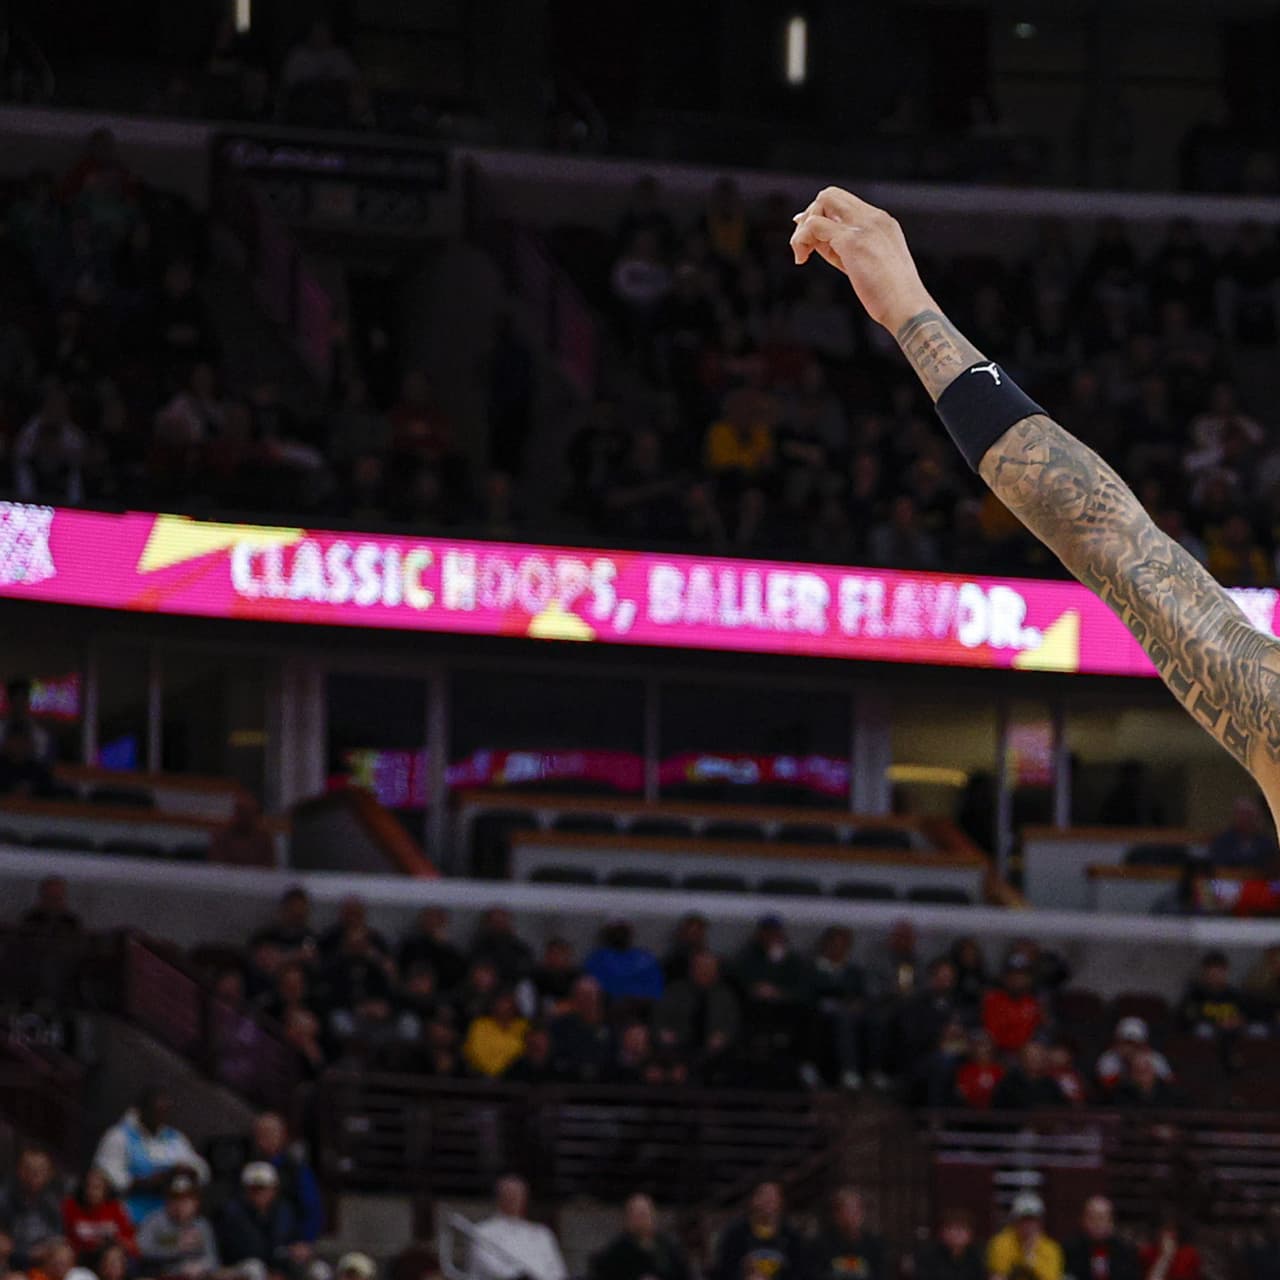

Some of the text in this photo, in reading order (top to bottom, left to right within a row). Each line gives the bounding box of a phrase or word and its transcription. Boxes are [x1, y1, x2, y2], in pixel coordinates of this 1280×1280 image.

[230, 538, 434, 611] CLASSIC
[441, 548, 637, 635] HOOPS,
[648, 563, 830, 636] BALLER
